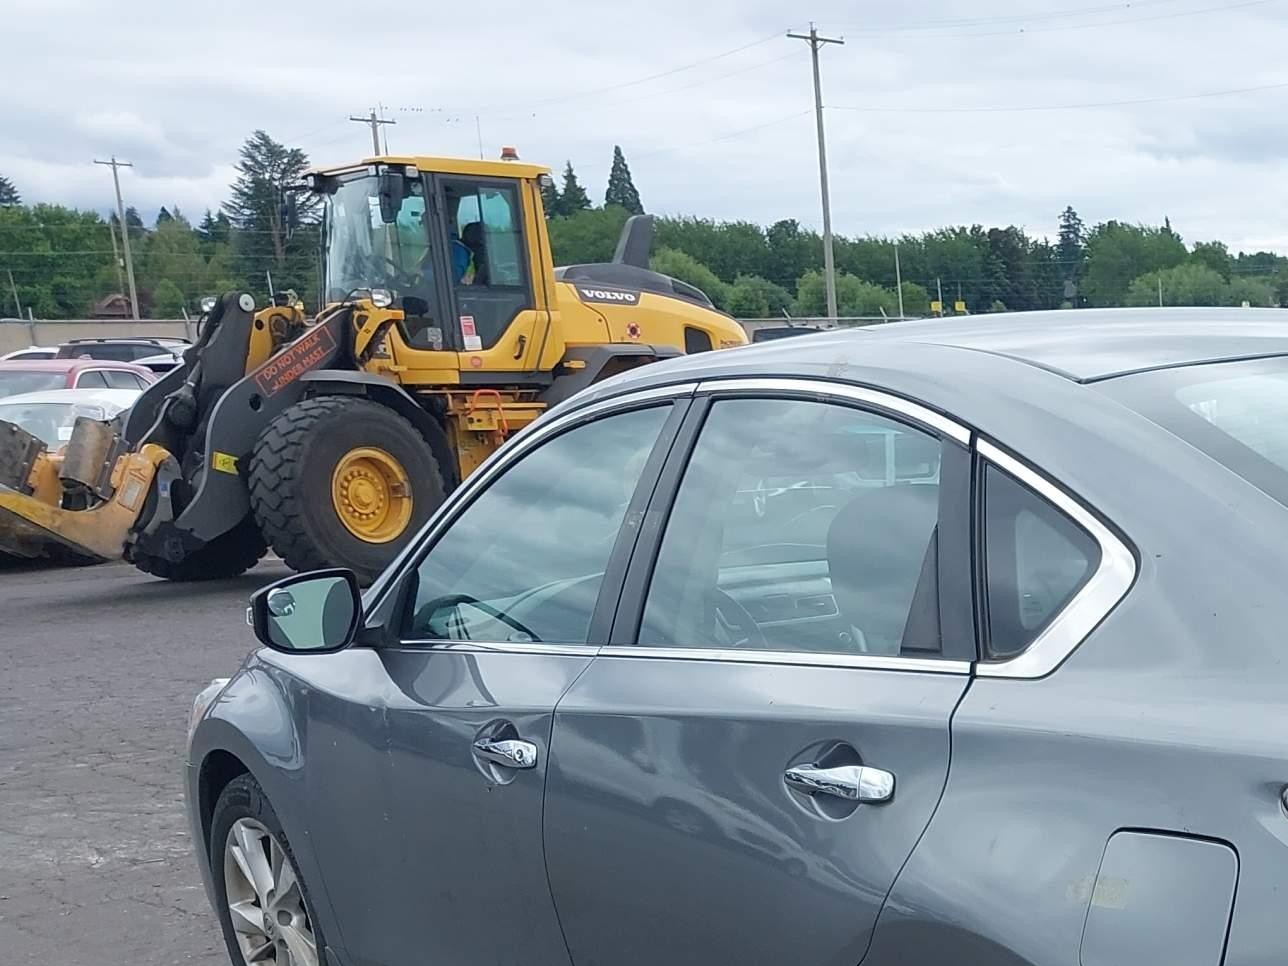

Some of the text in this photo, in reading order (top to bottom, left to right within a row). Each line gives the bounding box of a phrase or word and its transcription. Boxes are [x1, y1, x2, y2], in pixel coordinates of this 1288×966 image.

[581, 289, 636, 302] VOLVO
[263, 333, 321, 380] DO NOT WALK
[272, 346, 325, 390] UNDER MAST
